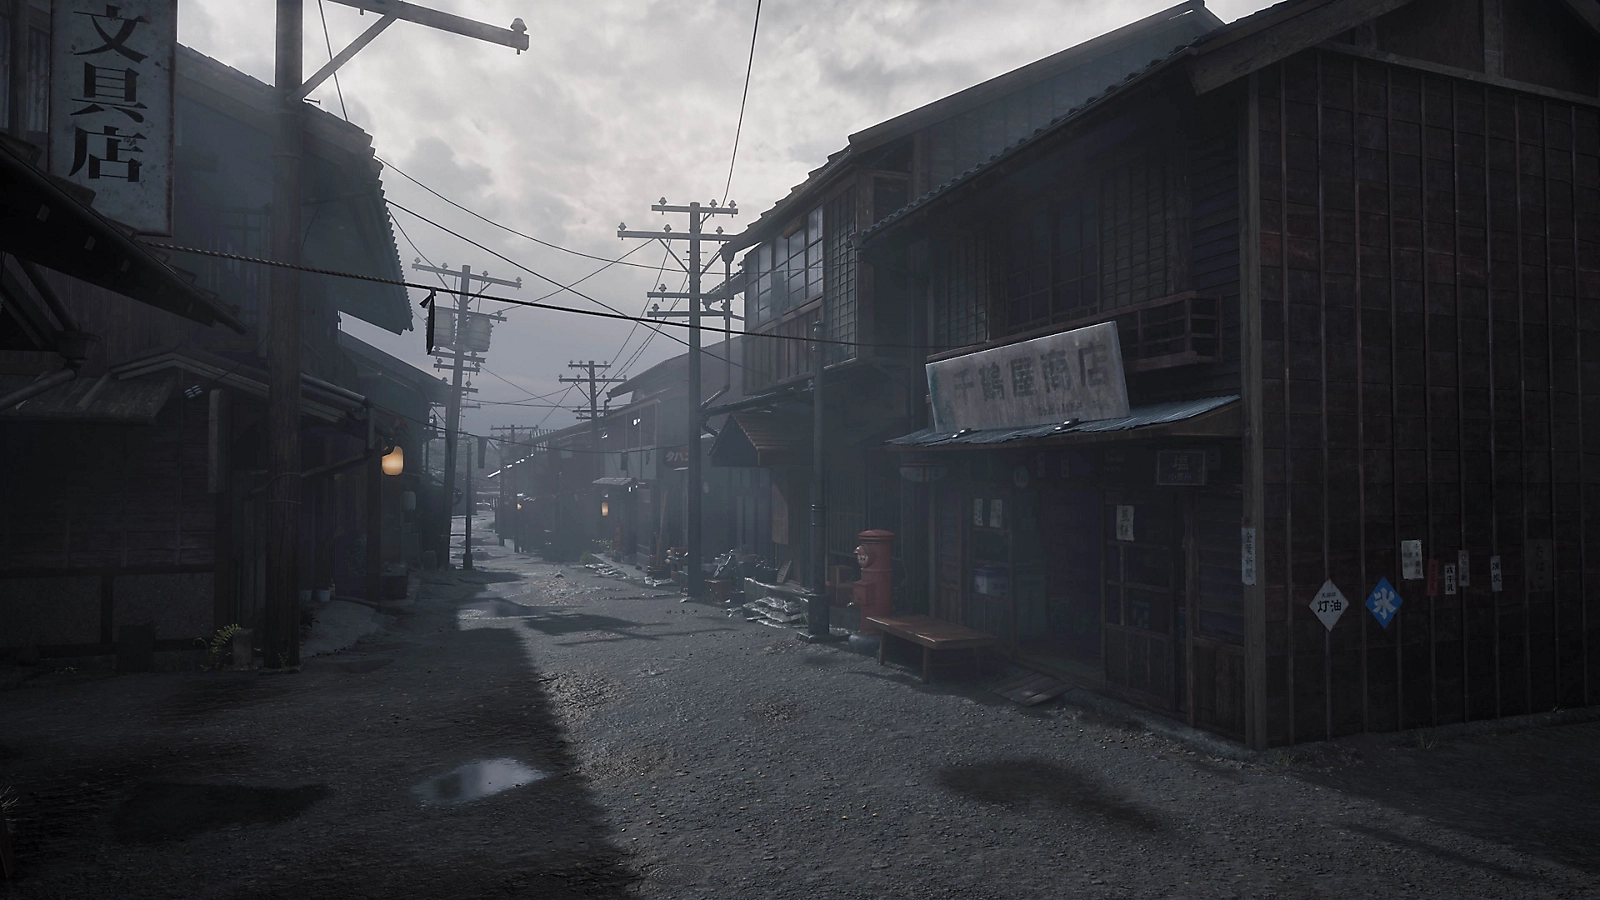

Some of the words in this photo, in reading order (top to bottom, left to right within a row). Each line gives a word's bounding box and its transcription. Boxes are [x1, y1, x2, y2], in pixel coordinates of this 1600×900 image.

[69, 4, 150, 182] 文具店
[1172, 454, 1190, 470] 塩
[1317, 599, 1342, 612] 灯油
[1373, 587, 1397, 619] 氷
